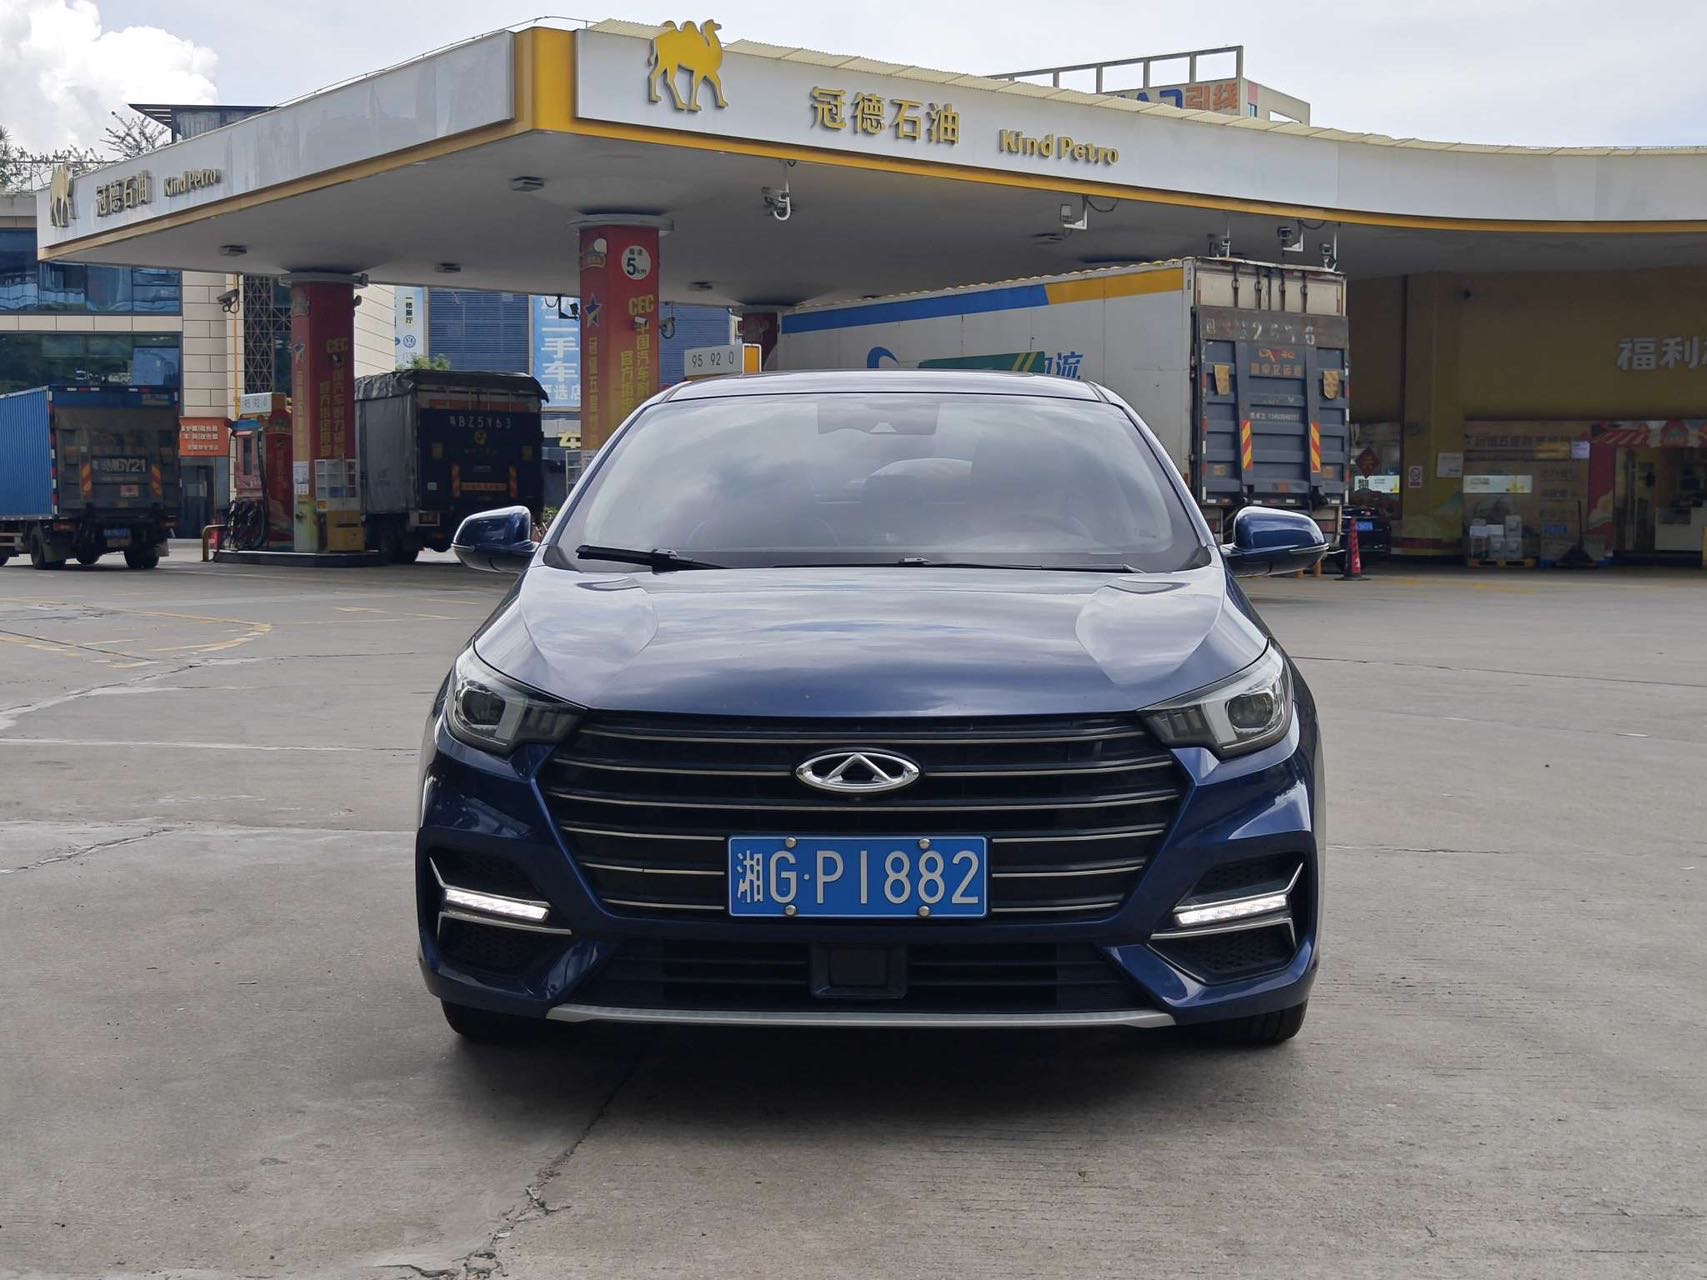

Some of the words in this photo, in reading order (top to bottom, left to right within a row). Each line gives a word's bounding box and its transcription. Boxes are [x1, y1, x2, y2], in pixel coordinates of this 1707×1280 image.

[810, 86, 960, 145] 冠德石油
[1000, 129, 1054, 156] Kind
[1057, 136, 1120, 166] Petro
[164, 171, 187, 197] Kind
[187, 169, 221, 191] Petro
[628, 295, 655, 316] CEC
[691, 354, 703, 368] 95
[710, 352, 721, 366] 92
[728, 351, 735, 365] 0
[1616, 336, 1707, 370] 福利
